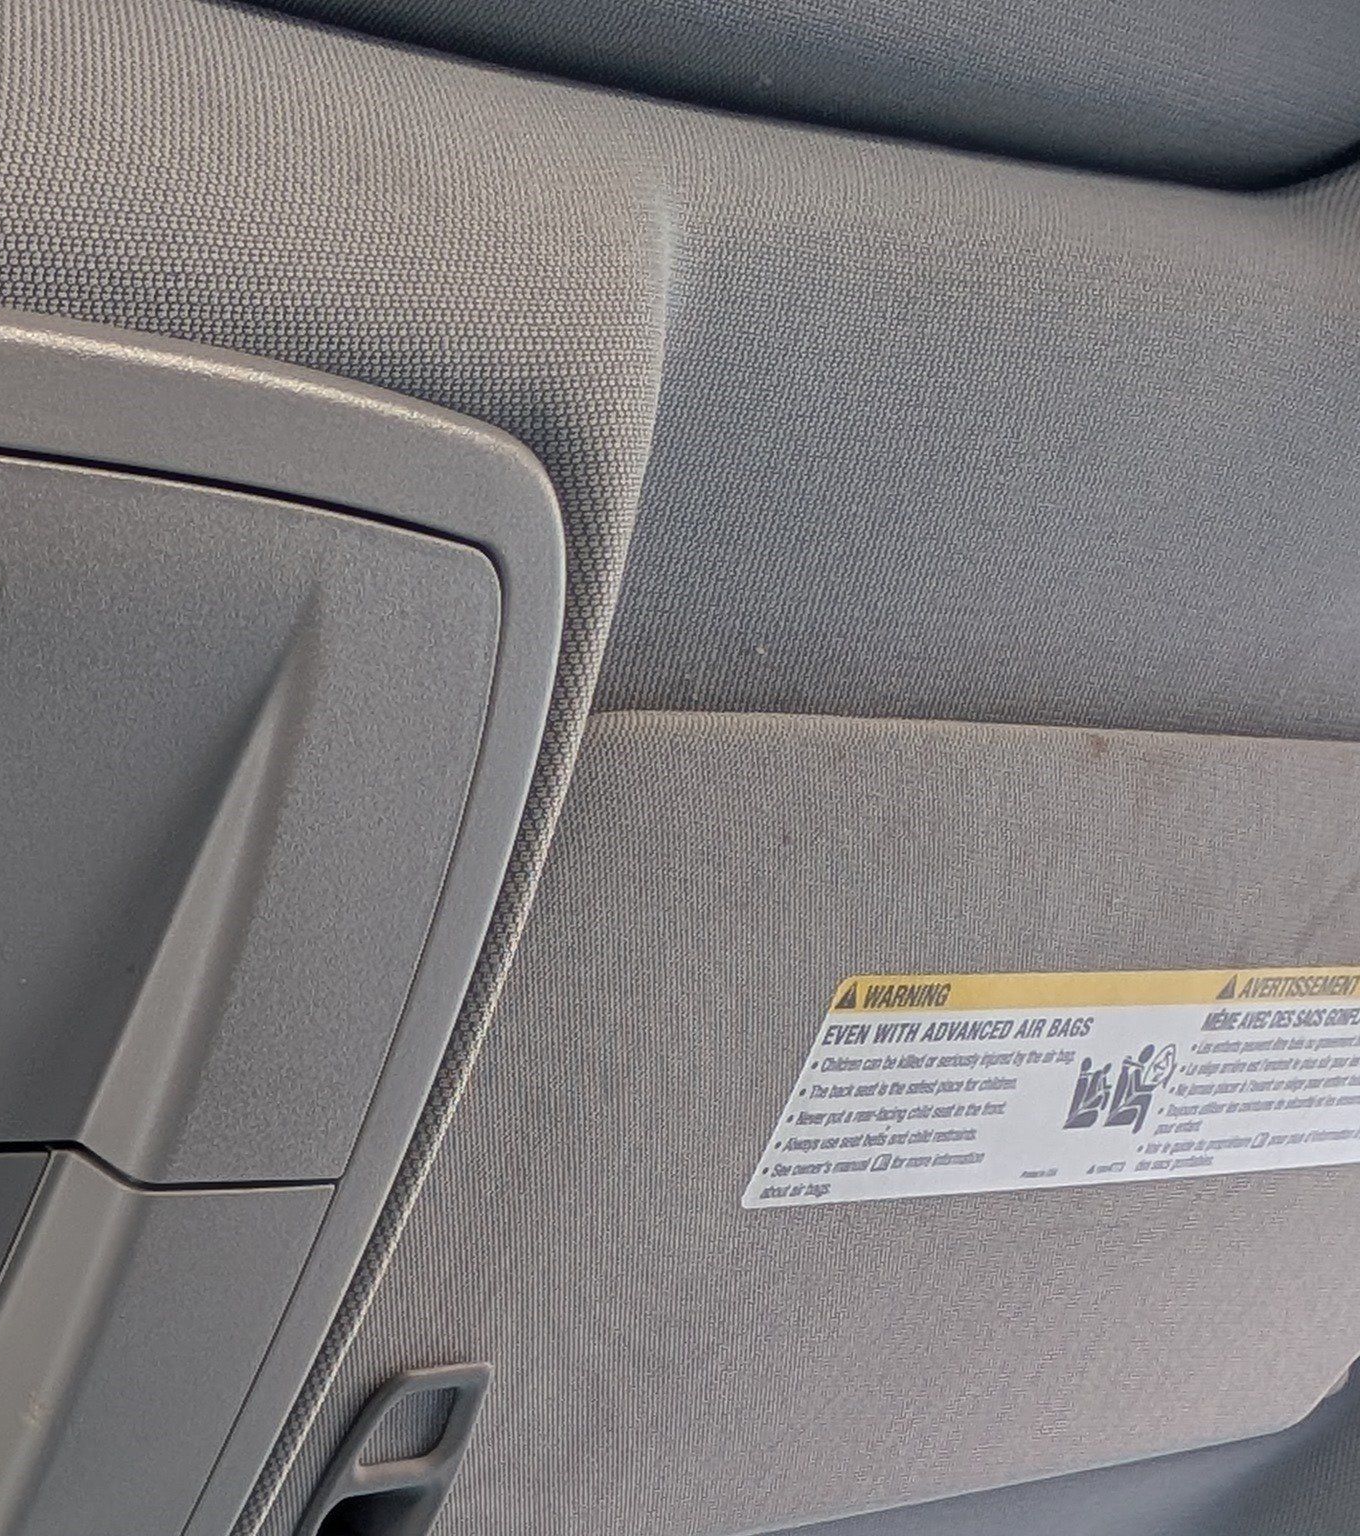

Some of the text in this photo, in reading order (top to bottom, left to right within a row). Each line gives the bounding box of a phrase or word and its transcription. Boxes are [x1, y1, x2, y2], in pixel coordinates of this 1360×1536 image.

[863, 983, 951, 1009] WARNING
[1238, 975, 1360, 999] AVERTISSEMENT
[1268, 1009, 1295, 1029] DES
[1293, 1008, 1327, 1027] SACS
[821, 1017, 1094, 1046] EVEN WITH ADVANCED AIR BAGS
